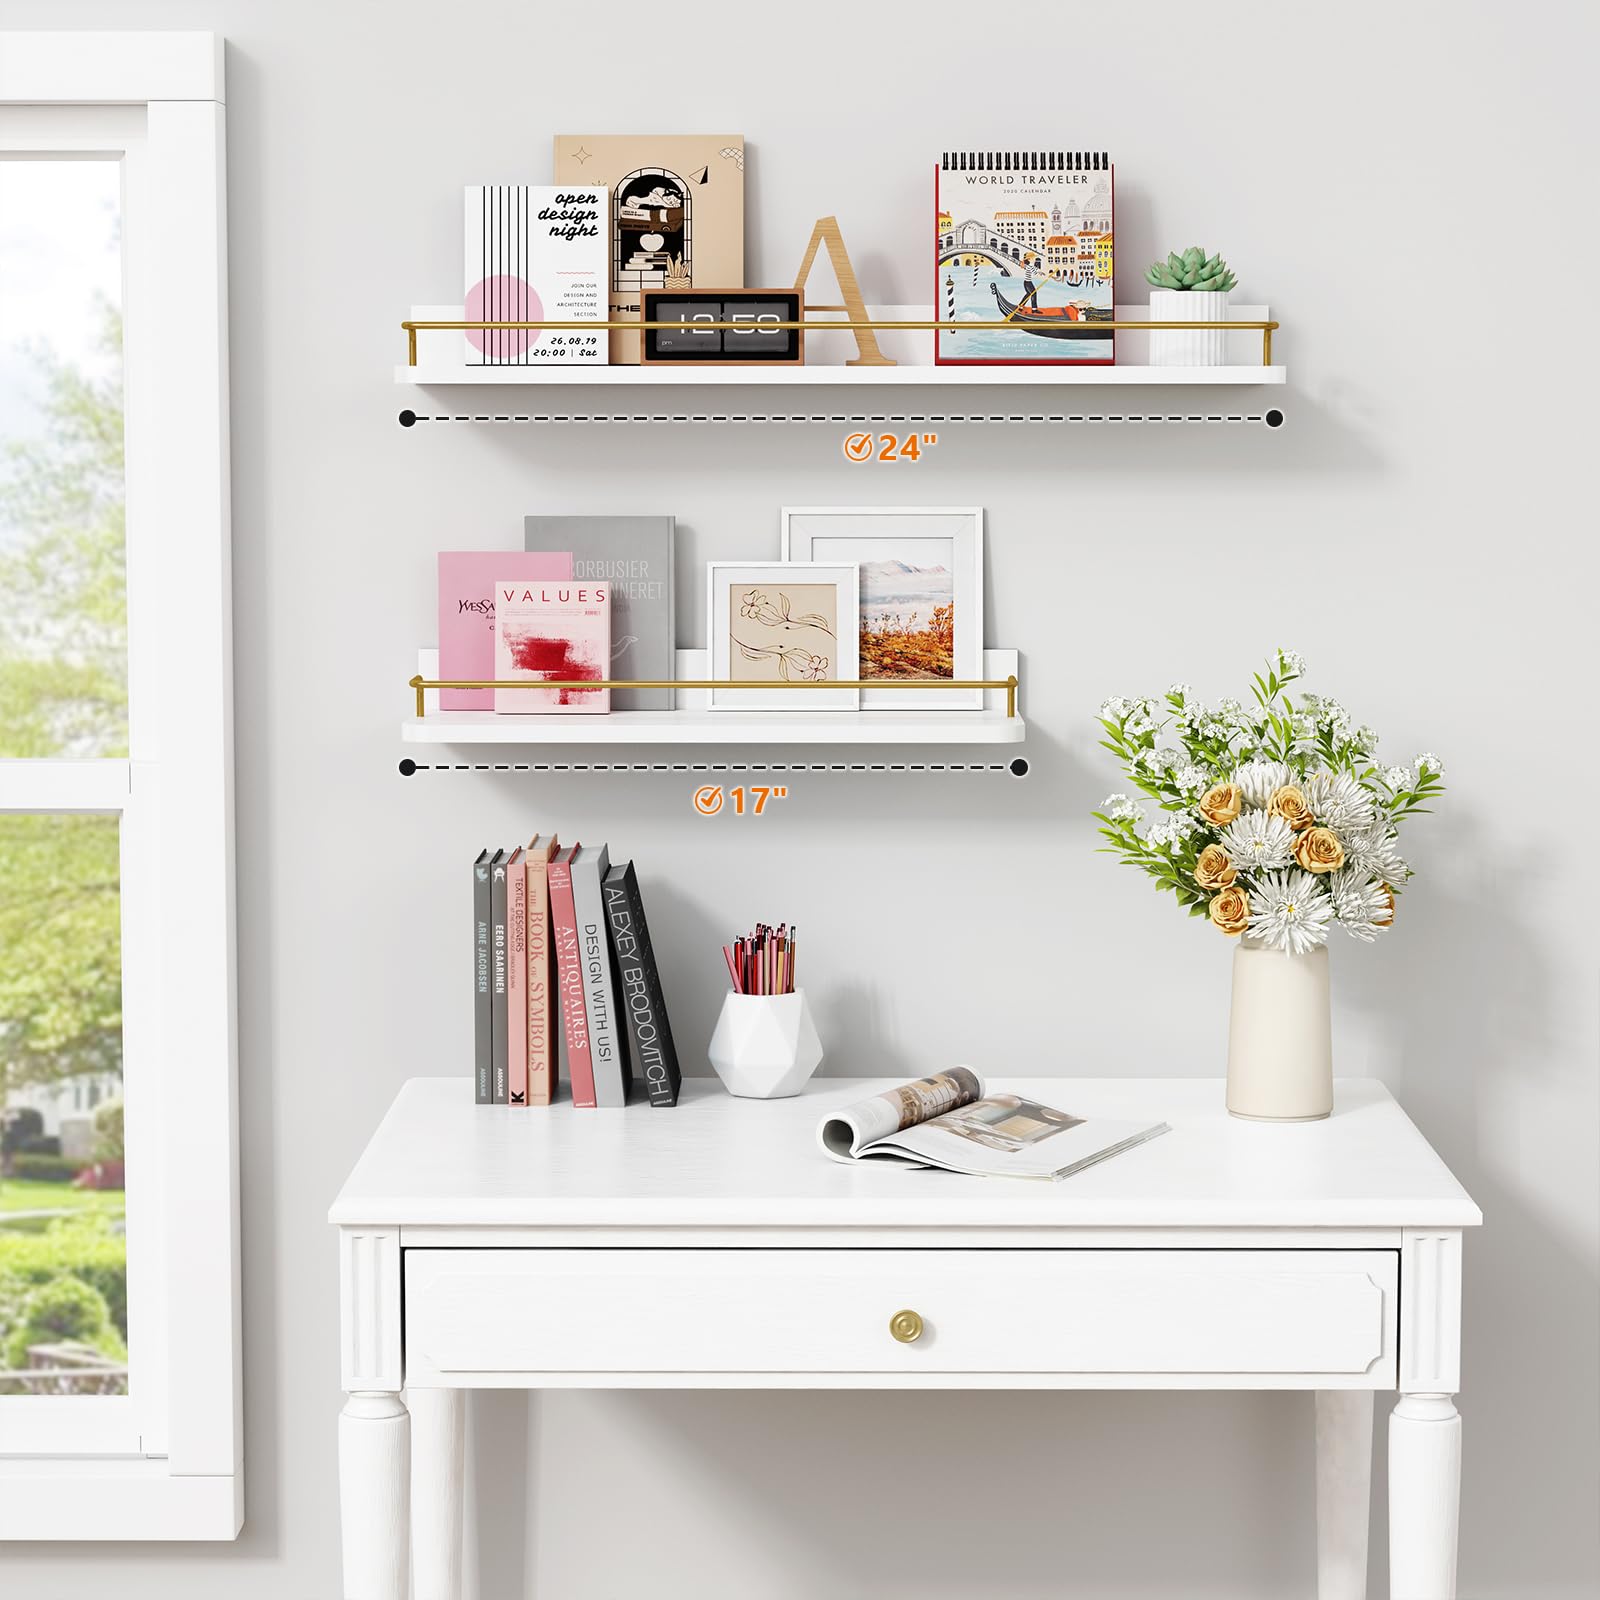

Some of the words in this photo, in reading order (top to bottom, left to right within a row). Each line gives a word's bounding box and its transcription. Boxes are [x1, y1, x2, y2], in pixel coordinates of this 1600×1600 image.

[965, 175, 1015, 185] WORLD
[1021, 175, 1088, 184] TRAVELER
[555, 194, 599, 208] open
[538, 207, 599, 225] design
[549, 223, 599, 241] night
[533, 349, 566, 357] 20:00
[578, 348, 598, 357] Sat
[550, 337, 597, 345] 26.08.19
[503, 590, 606, 602] VALUES
[515, 878, 524, 907] TEXTILE
[478, 921, 487, 945] ARNE
[495, 925, 505, 947] EERO
[515, 909, 524, 953] DESIGNERS
[530, 912, 544, 961] BOOK
[585, 924, 603, 984] DESIGN
[478, 948, 487, 993] JACOBSEN
[495, 949, 505, 994] SAARINEN
[562, 926, 587, 1049] ANTIQUAIRES
[605, 887, 640, 961] ALEXEY
[624, 967, 669, 1095] BRODOVITCH
[592, 989, 609, 1031] WITH
[530, 982, 545, 1072] SYMBOLS
[597, 1036, 612, 1062] US!
